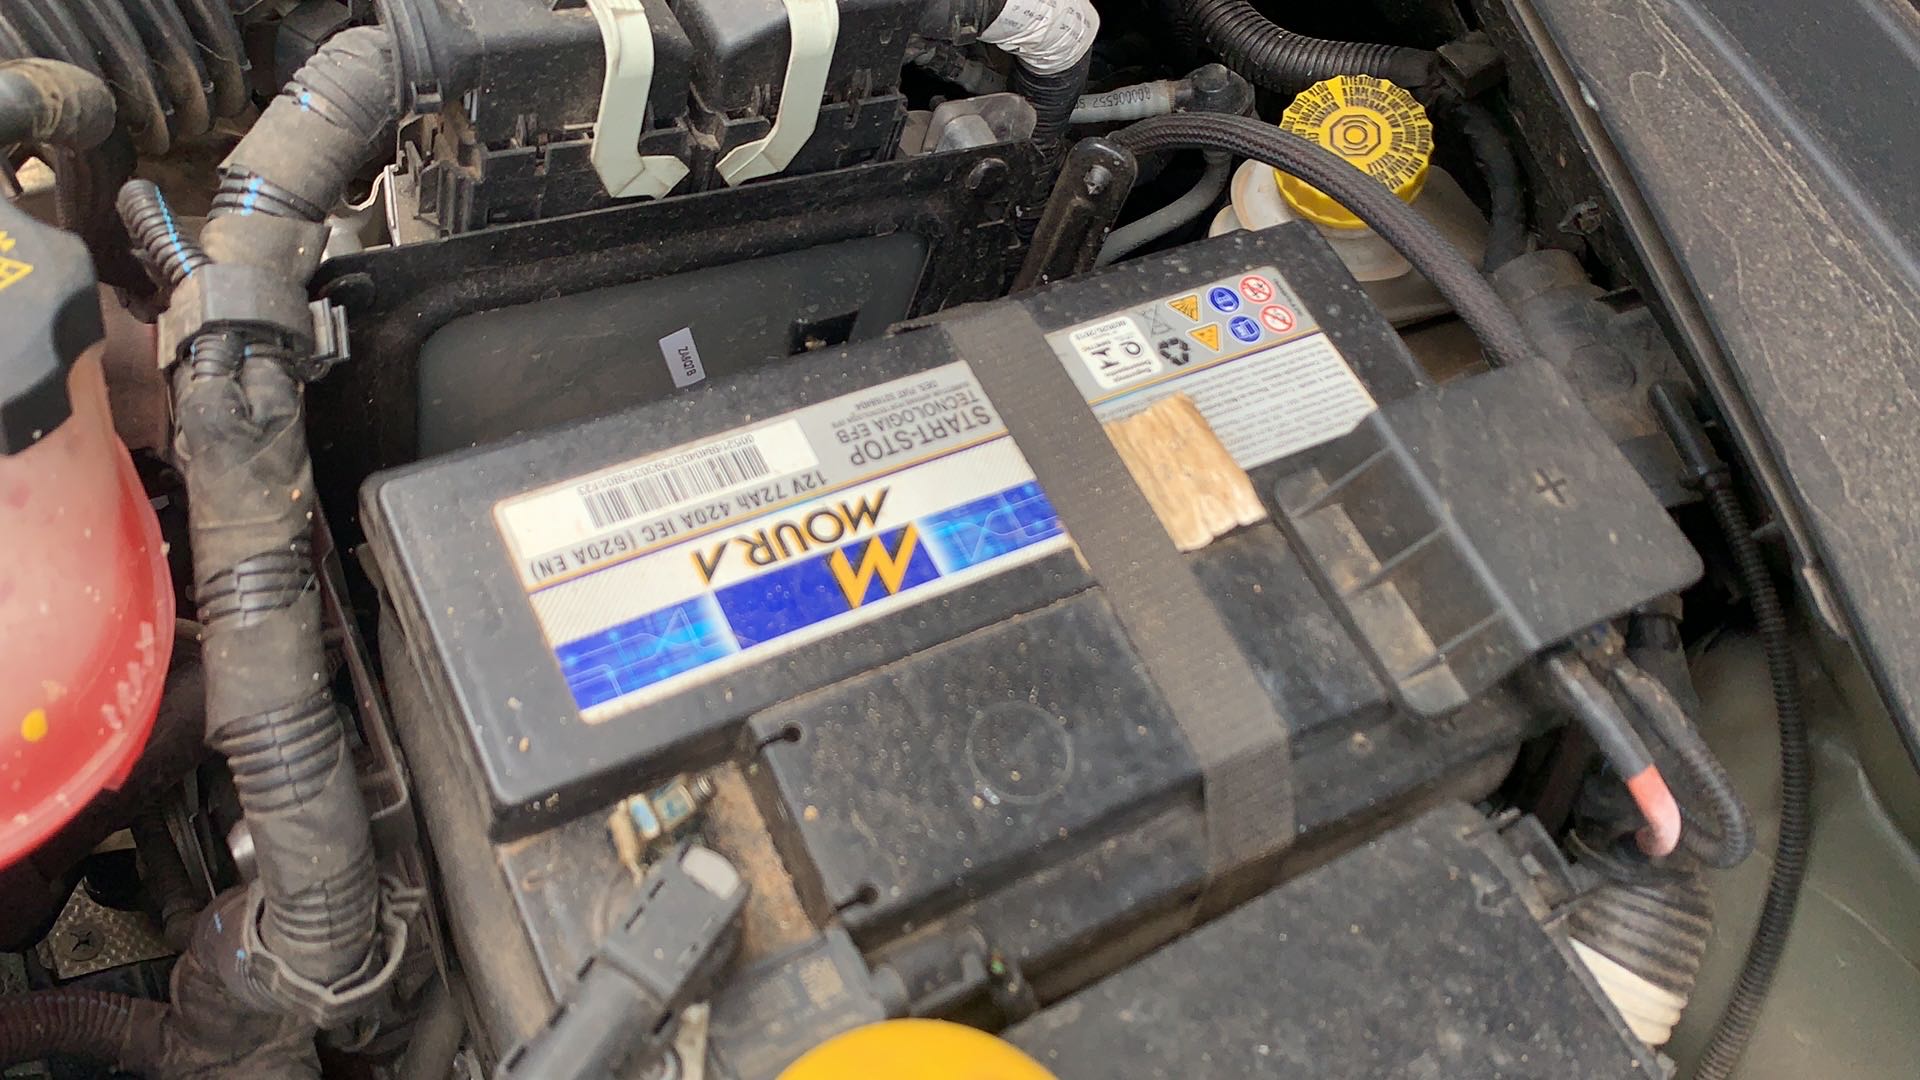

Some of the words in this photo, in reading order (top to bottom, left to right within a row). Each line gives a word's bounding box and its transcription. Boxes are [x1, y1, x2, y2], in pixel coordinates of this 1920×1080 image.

[872, 388, 978, 431] TECNOLOGIA
[835, 421, 870, 444] EFB
[851, 404, 991, 466] START-STOP
[793, 469, 828, 493] 12V
[735, 482, 785, 511] 72Ah
[680, 500, 731, 529] 420A
[640, 518, 675, 542] IEC
[689, 486, 889, 585] MOURA
[571, 529, 636, 565] (620A
[527, 551, 566, 579] EN)
